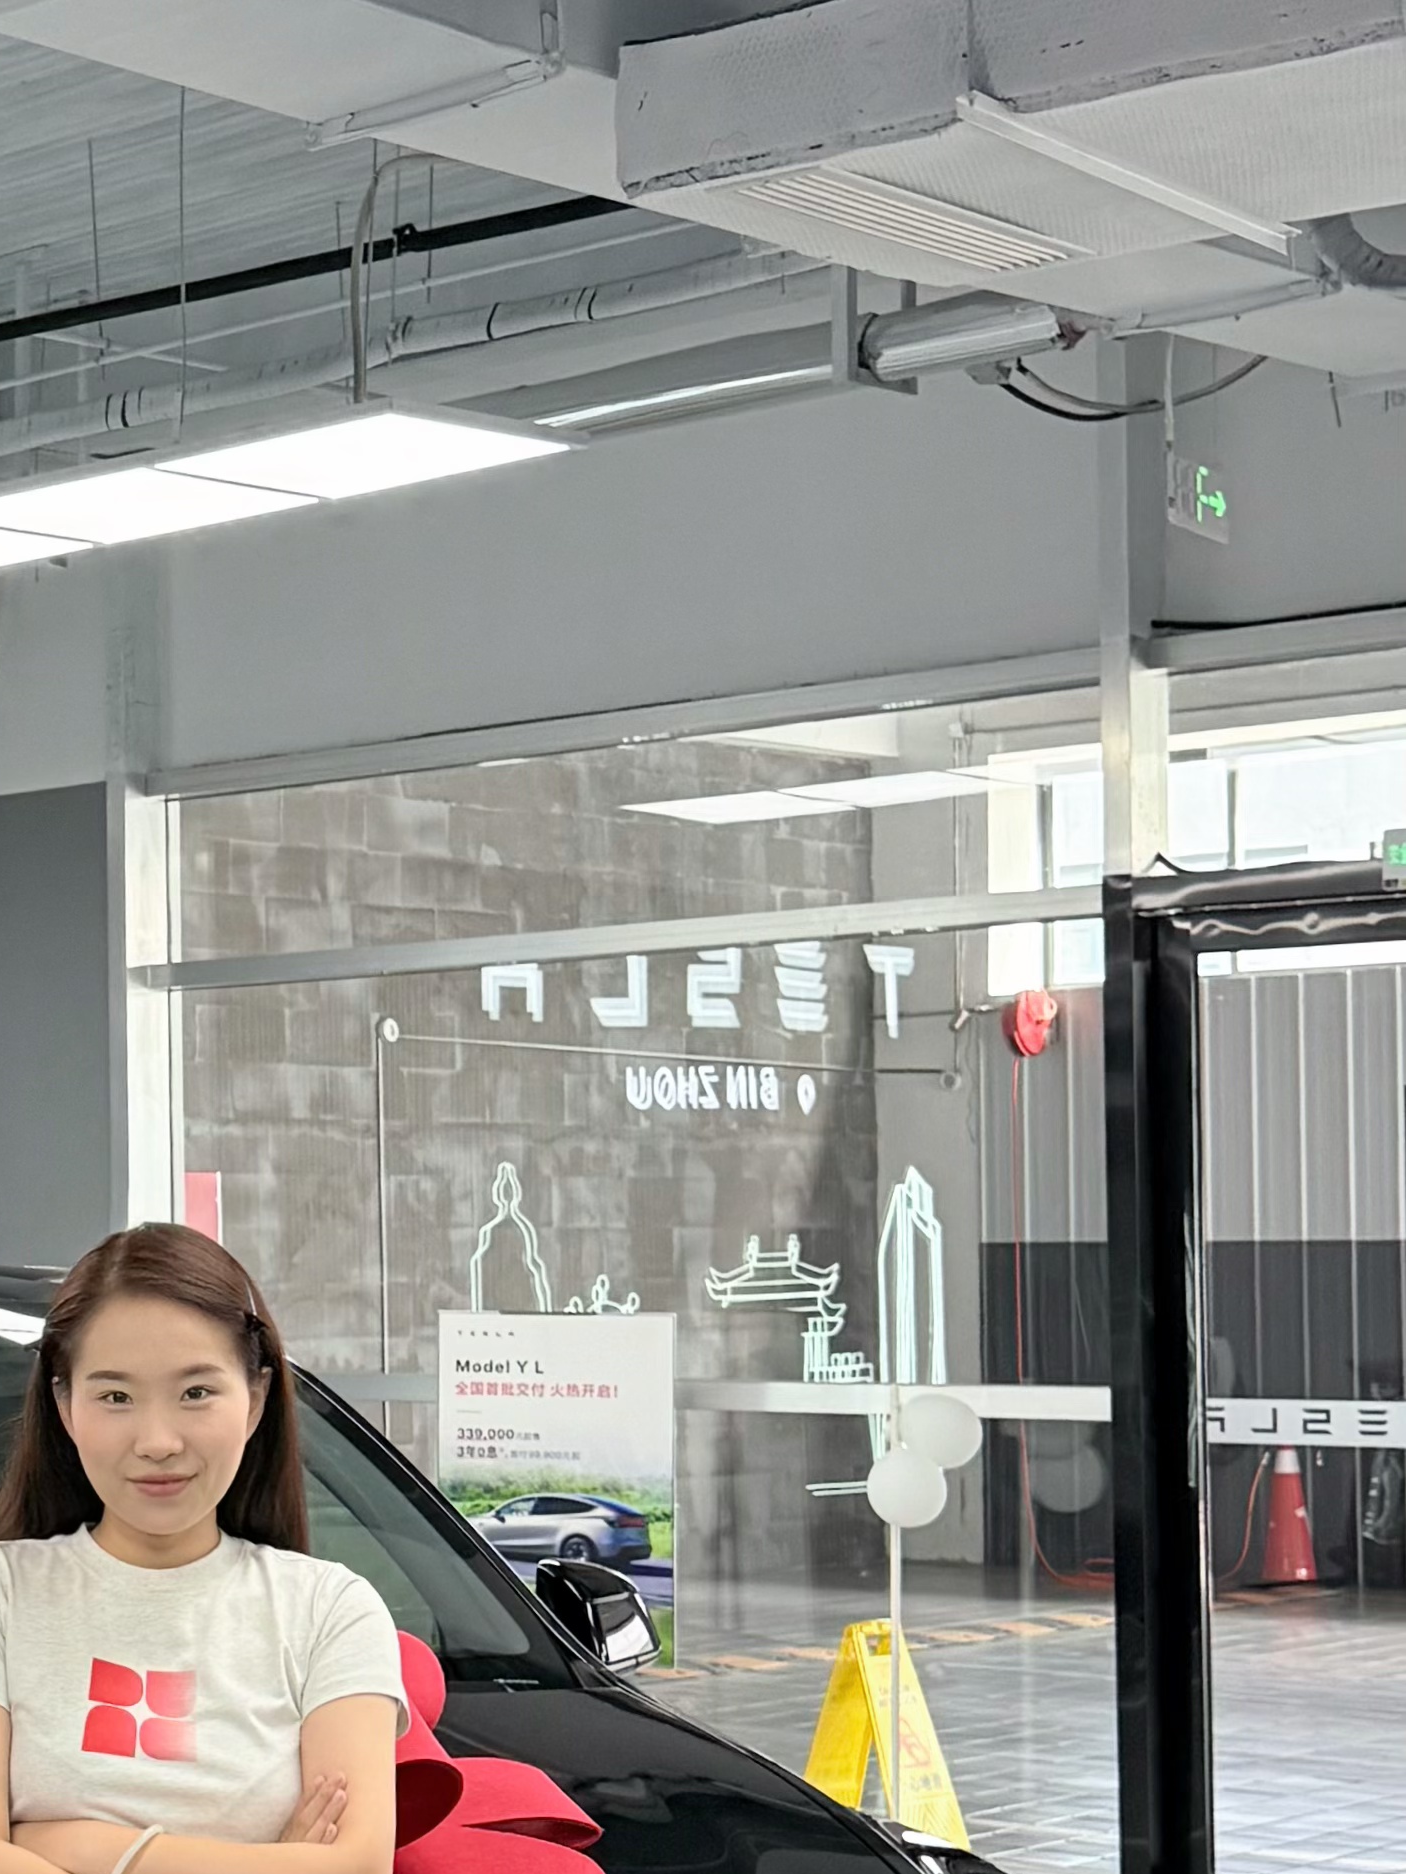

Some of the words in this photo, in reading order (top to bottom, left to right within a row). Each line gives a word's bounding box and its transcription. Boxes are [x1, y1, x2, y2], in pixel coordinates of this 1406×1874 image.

[455, 1359, 510, 1374] Model
[516, 1360, 528, 1374] Y
[534, 1361, 544, 1374] L
[455, 1381, 545, 1398] 全国首批交付
